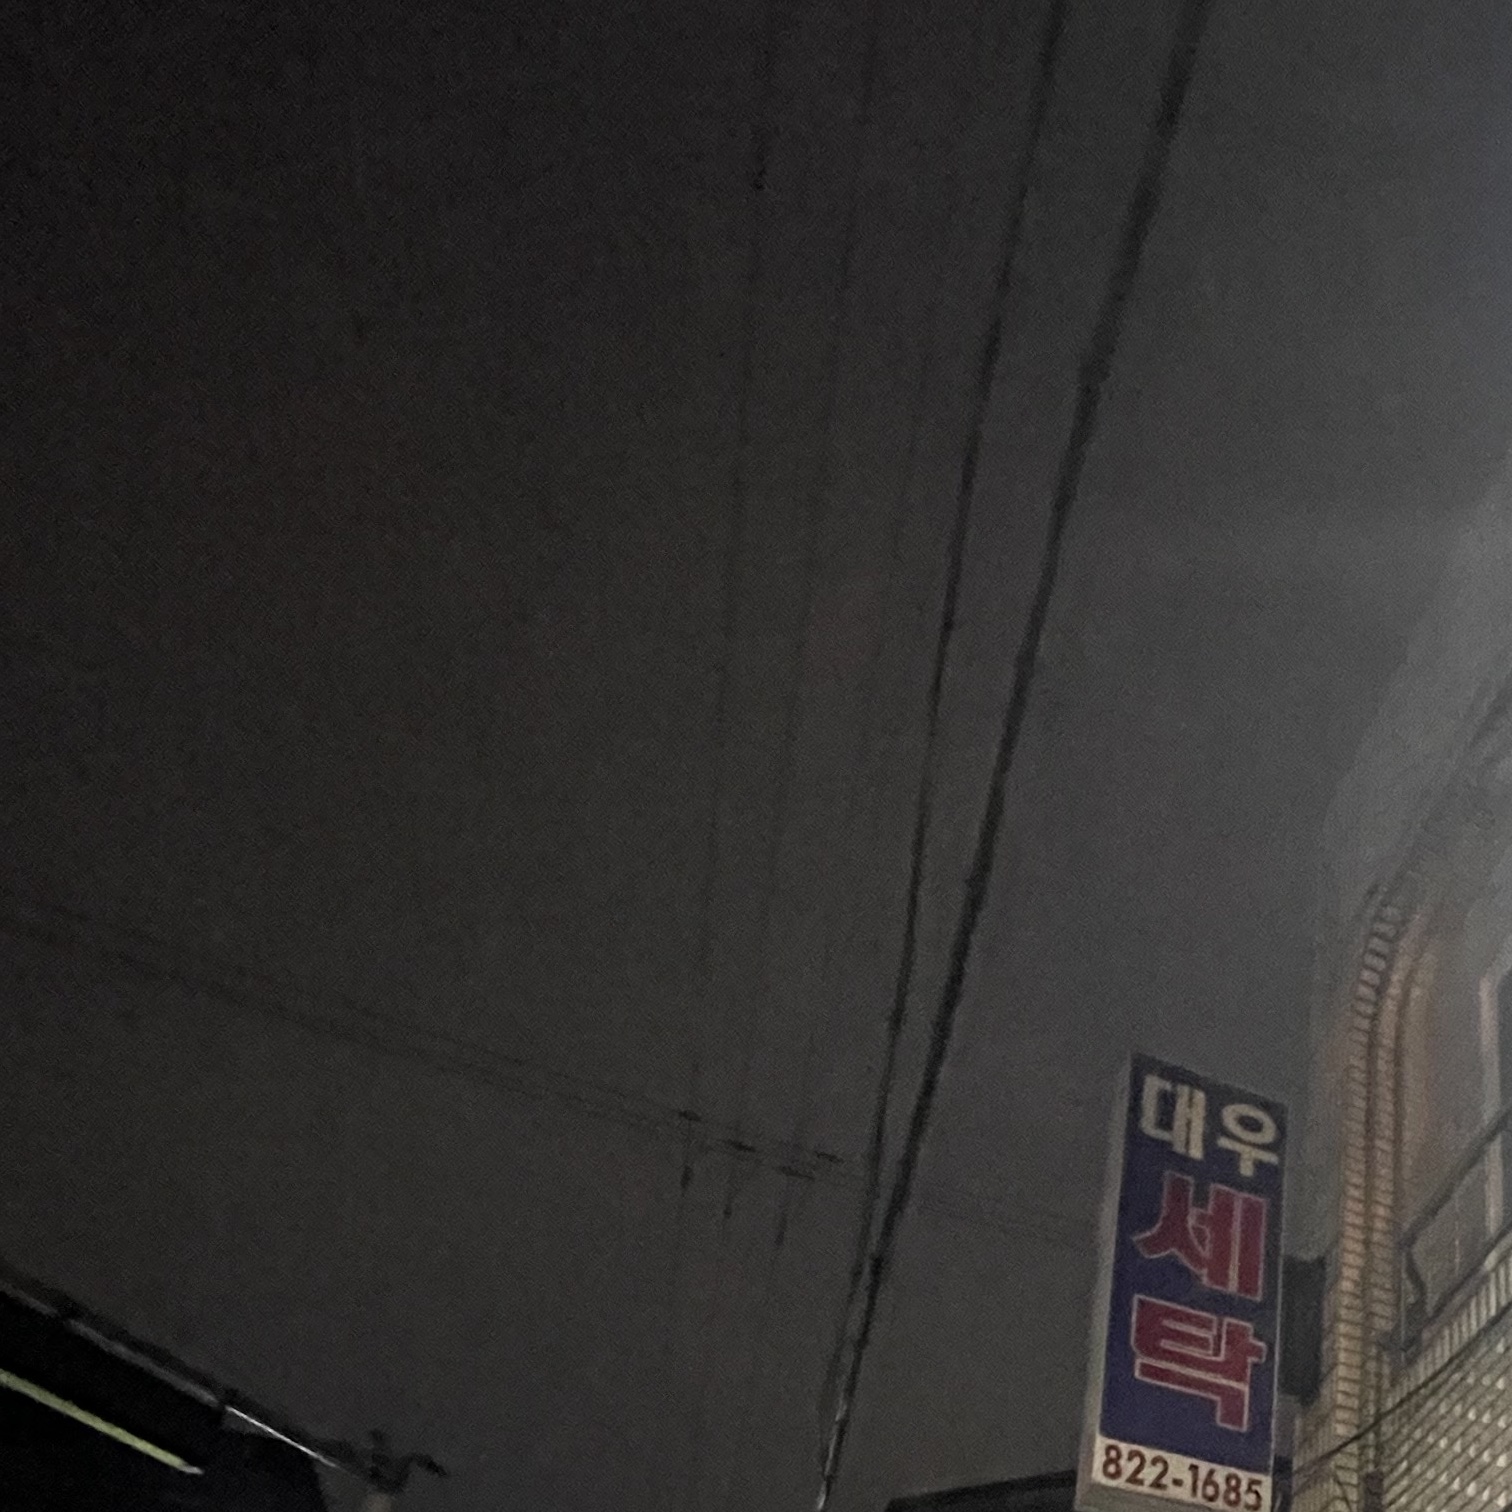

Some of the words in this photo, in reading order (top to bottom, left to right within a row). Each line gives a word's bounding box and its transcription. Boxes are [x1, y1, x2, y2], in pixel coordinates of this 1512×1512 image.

[1138, 1073, 1279, 1177] 대우
[1131, 1170, 1268, 1434] 세탁
[1101, 1443, 1264, 1512] 822-1685
